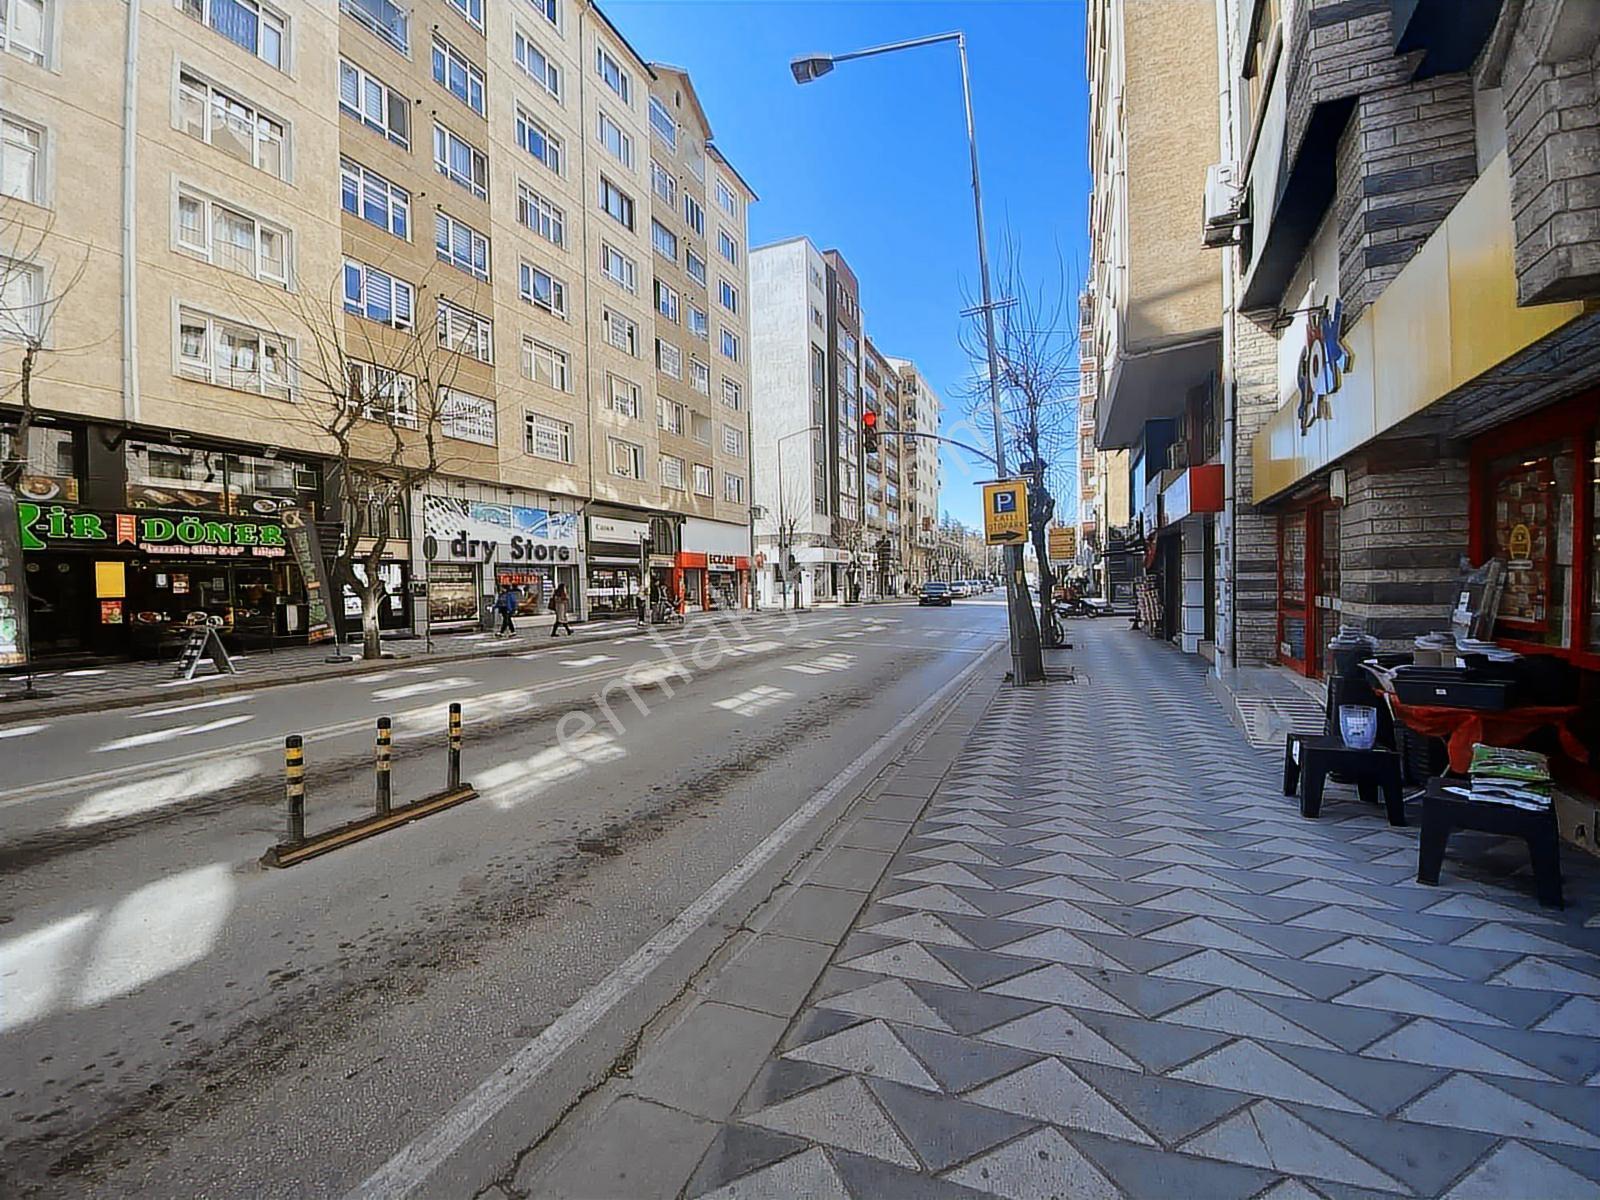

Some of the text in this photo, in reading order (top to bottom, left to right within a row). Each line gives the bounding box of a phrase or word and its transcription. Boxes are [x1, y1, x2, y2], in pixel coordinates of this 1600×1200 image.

[996, 493, 1012, 512] P
[142, 515, 286, 547] DÖNER
[988, 521, 1024, 531] OTOPARK
[451, 530, 570, 564] dry Store
[709, 553, 735, 565] ECZANE
